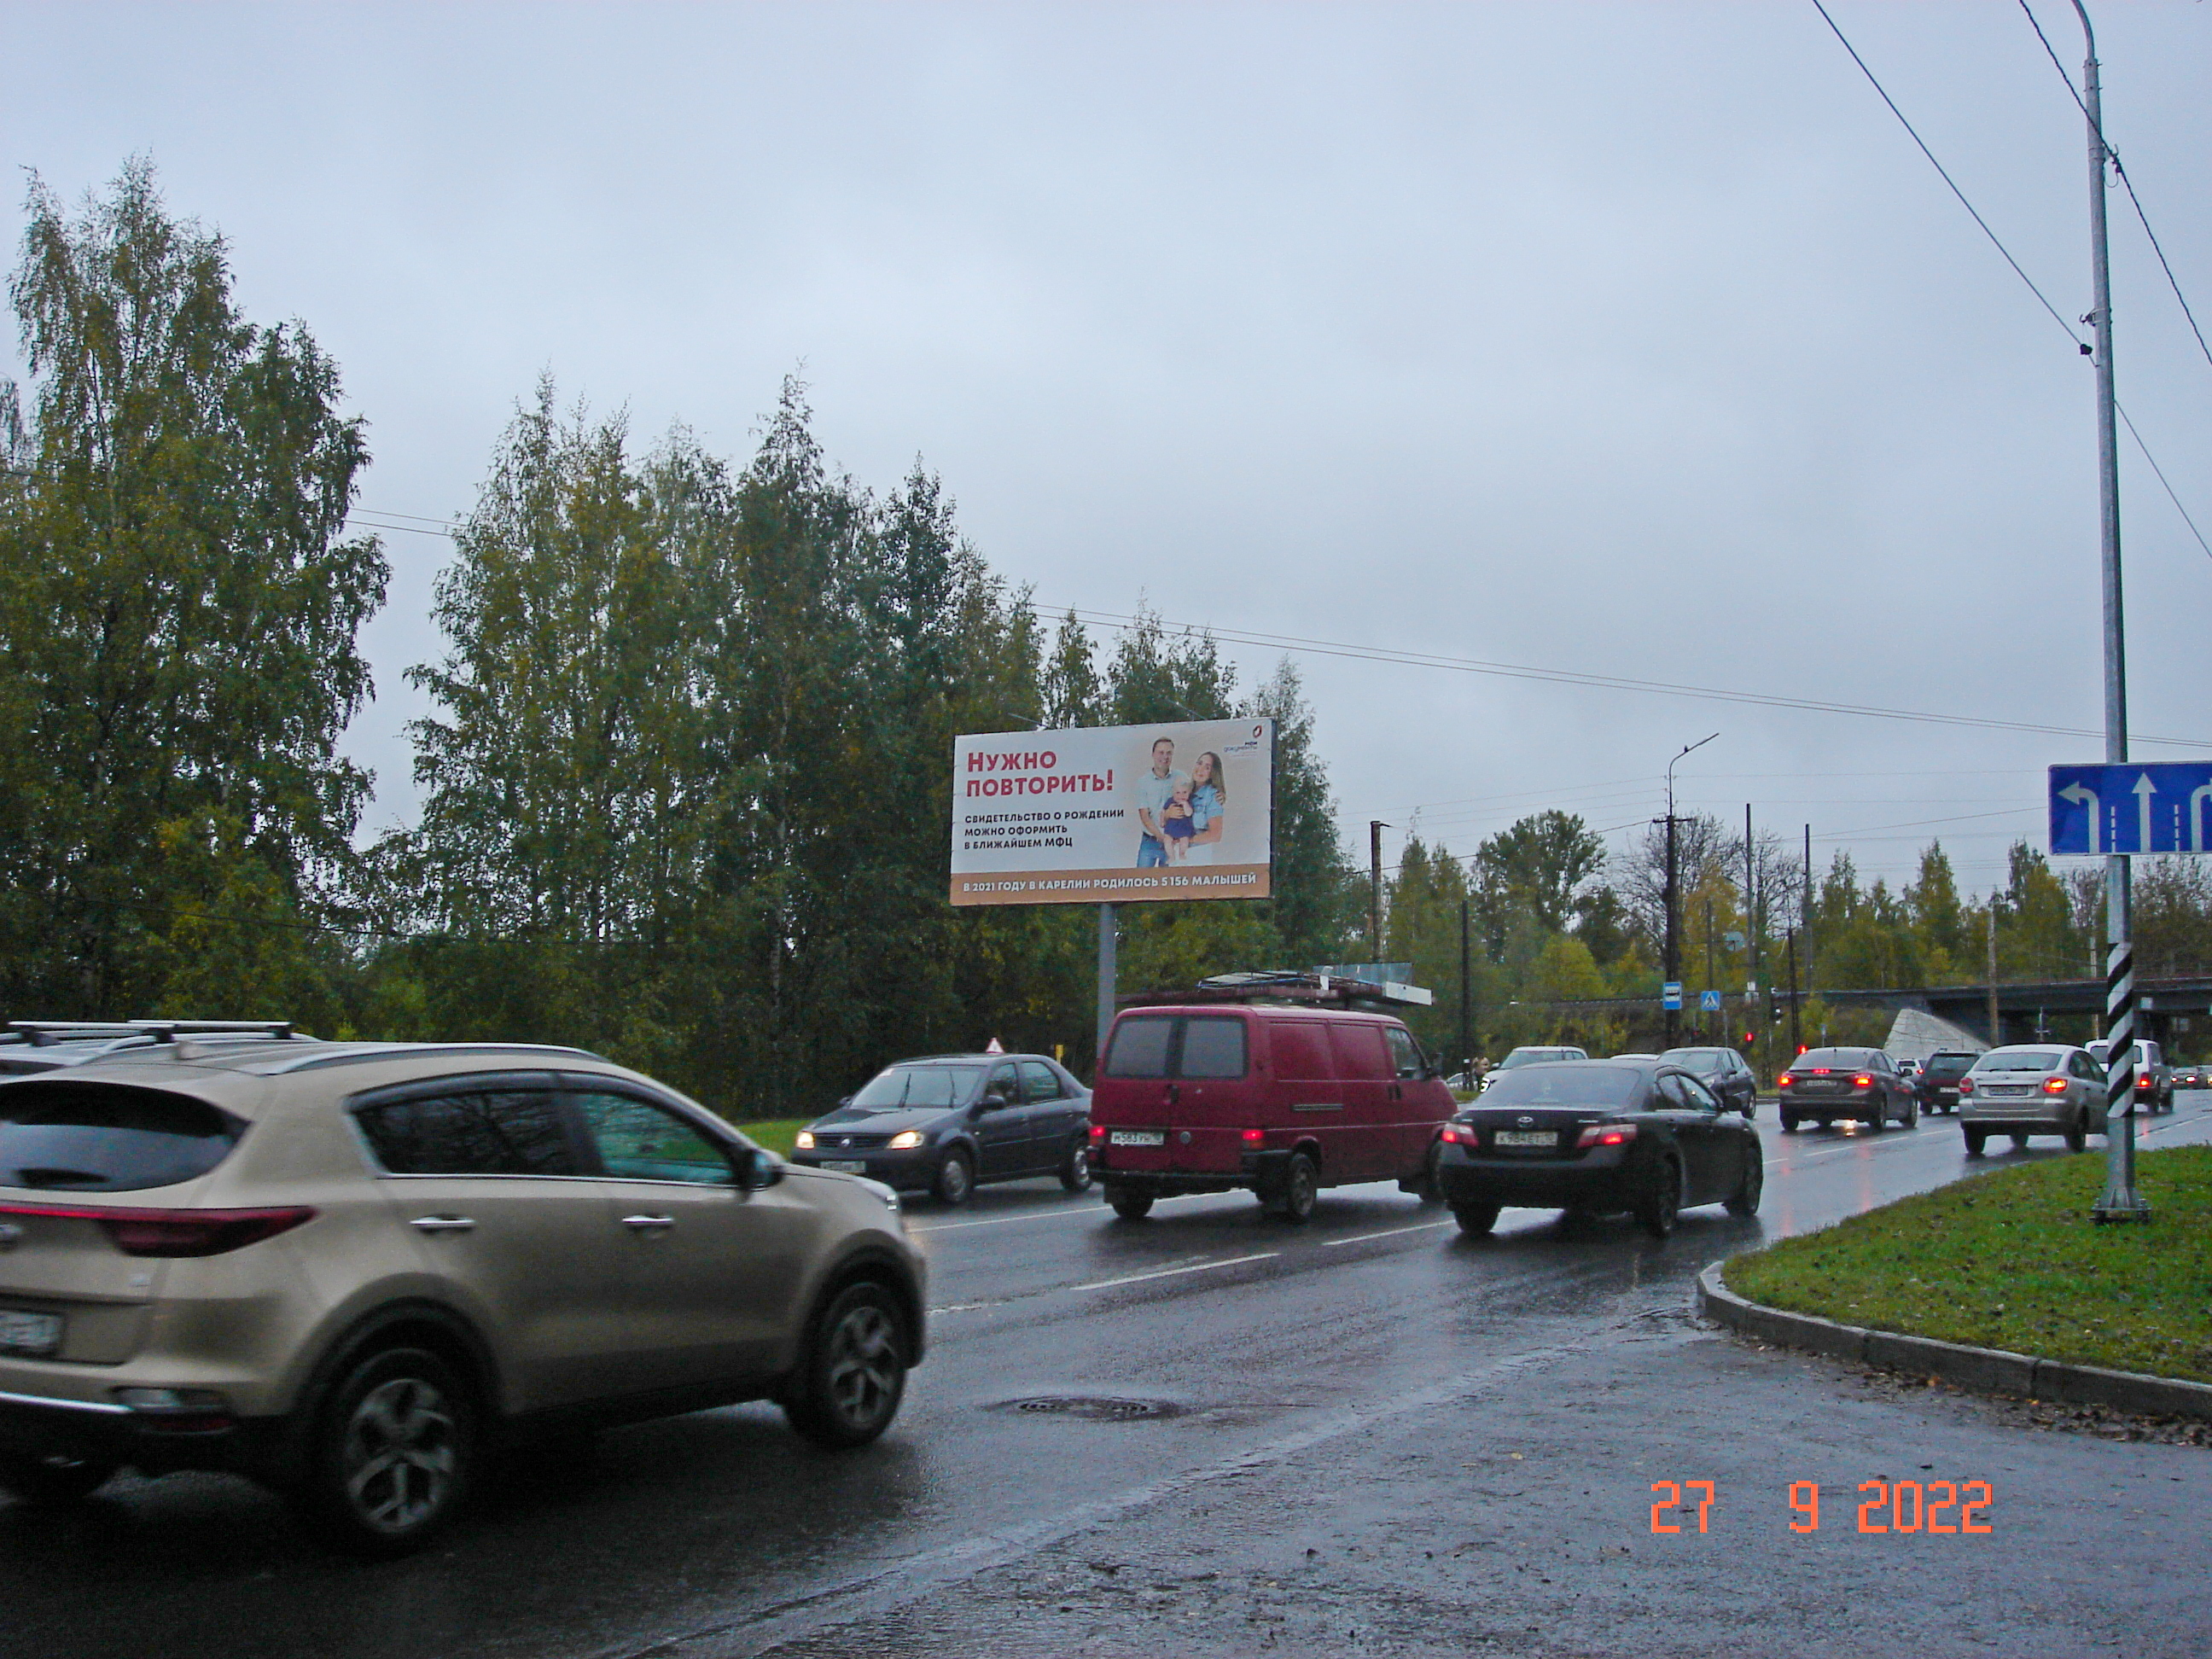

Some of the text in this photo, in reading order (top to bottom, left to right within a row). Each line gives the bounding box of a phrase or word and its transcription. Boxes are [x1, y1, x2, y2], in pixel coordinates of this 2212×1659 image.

[968, 751, 1057, 772] НУЖНО
[966, 769, 1114, 797] ПОВТОРИТЬ!
[964, 809, 1124, 824] СВИДЕТЕЛЬСТВО О РОЖДЕНИИ
[964, 825, 1068, 836] МОЖНО ОФОРМИТЬ
[973, 838, 1042, 849] БЛИЖАЙШЕМ
[1045, 836, 1073, 847] МФЦ
[963, 882, 969, 892] В
[972, 882, 995, 892] 2021
[998, 882, 1027, 892] ГОДУ
[1028, 881, 1036, 890] В
[1039, 879, 1091, 890] КАРЕЛИИ
[1093, 876, 1159, 889] РОДИЛОСЬ
[1191, 872, 1257, 886] МАЛЫШЕЙ
